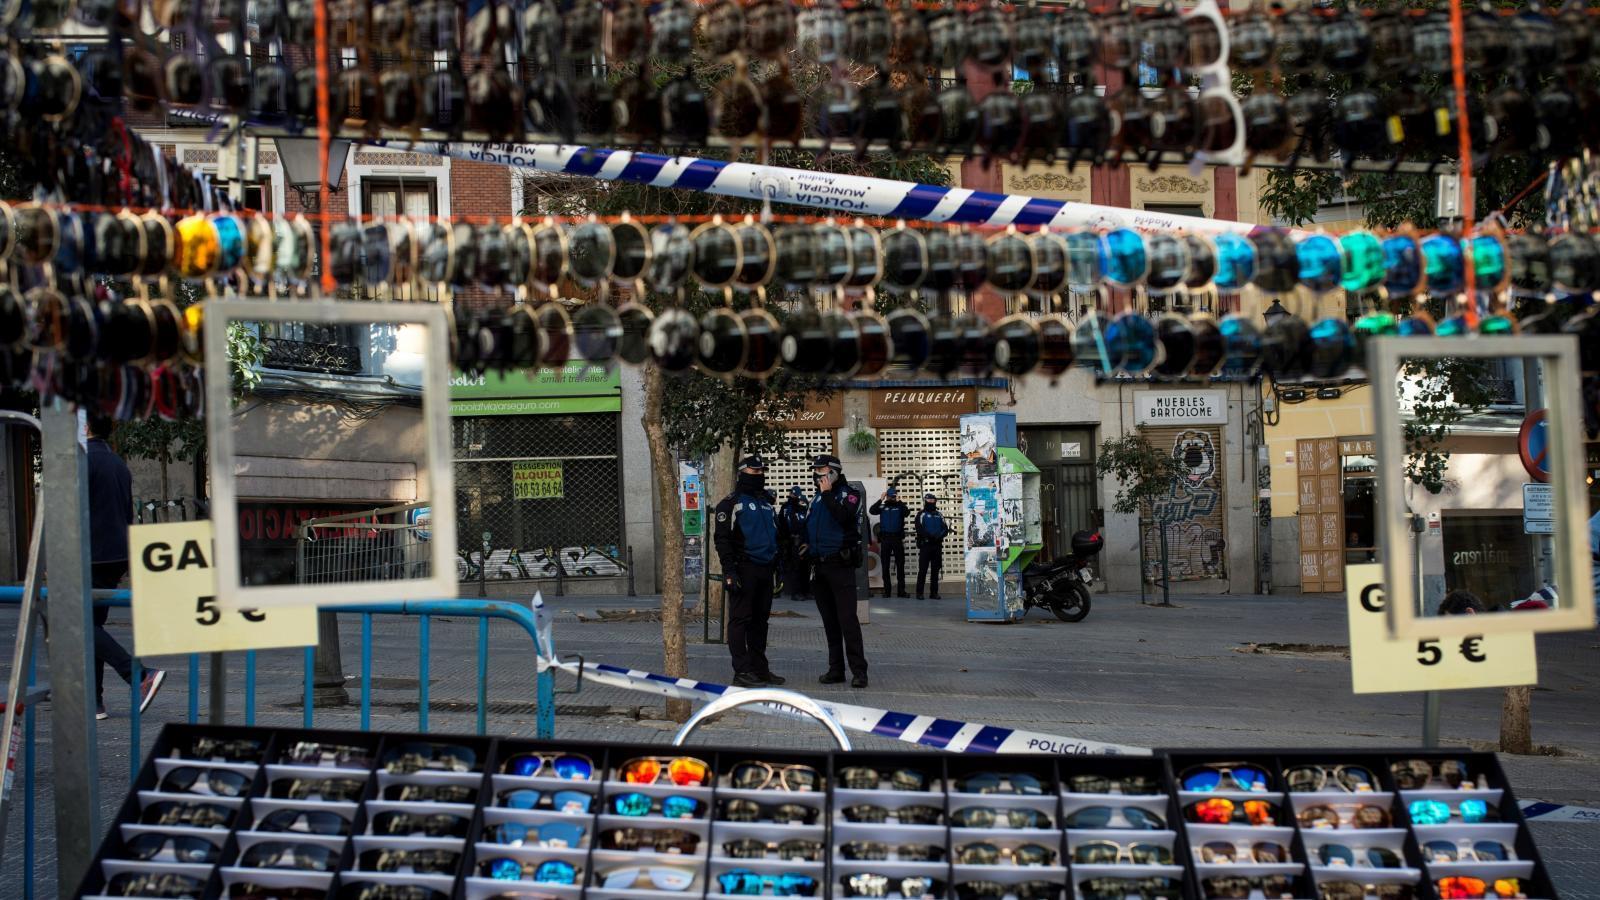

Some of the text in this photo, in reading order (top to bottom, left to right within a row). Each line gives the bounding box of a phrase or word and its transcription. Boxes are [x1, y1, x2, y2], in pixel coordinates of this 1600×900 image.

[797, 174, 836, 184] Madrid
[798, 182, 864, 197] MUNICIPAL
[1134, 215, 1173, 228] Madrid
[884, 389, 965, 404] PELUQUERÍA
[1156, 397, 1205, 408] MUEBLES
[1150, 406, 1213, 418] BARTOLOME
[514, 470, 562, 480] ALQUILA
[514, 480, 563, 497] 610 53 64 64
[142, 539, 215, 572] GA
[195, 596, 221, 626] 5
[1416, 635, 1487, 666] 5 €
[1029, 739, 1087, 754] POLICÍA
